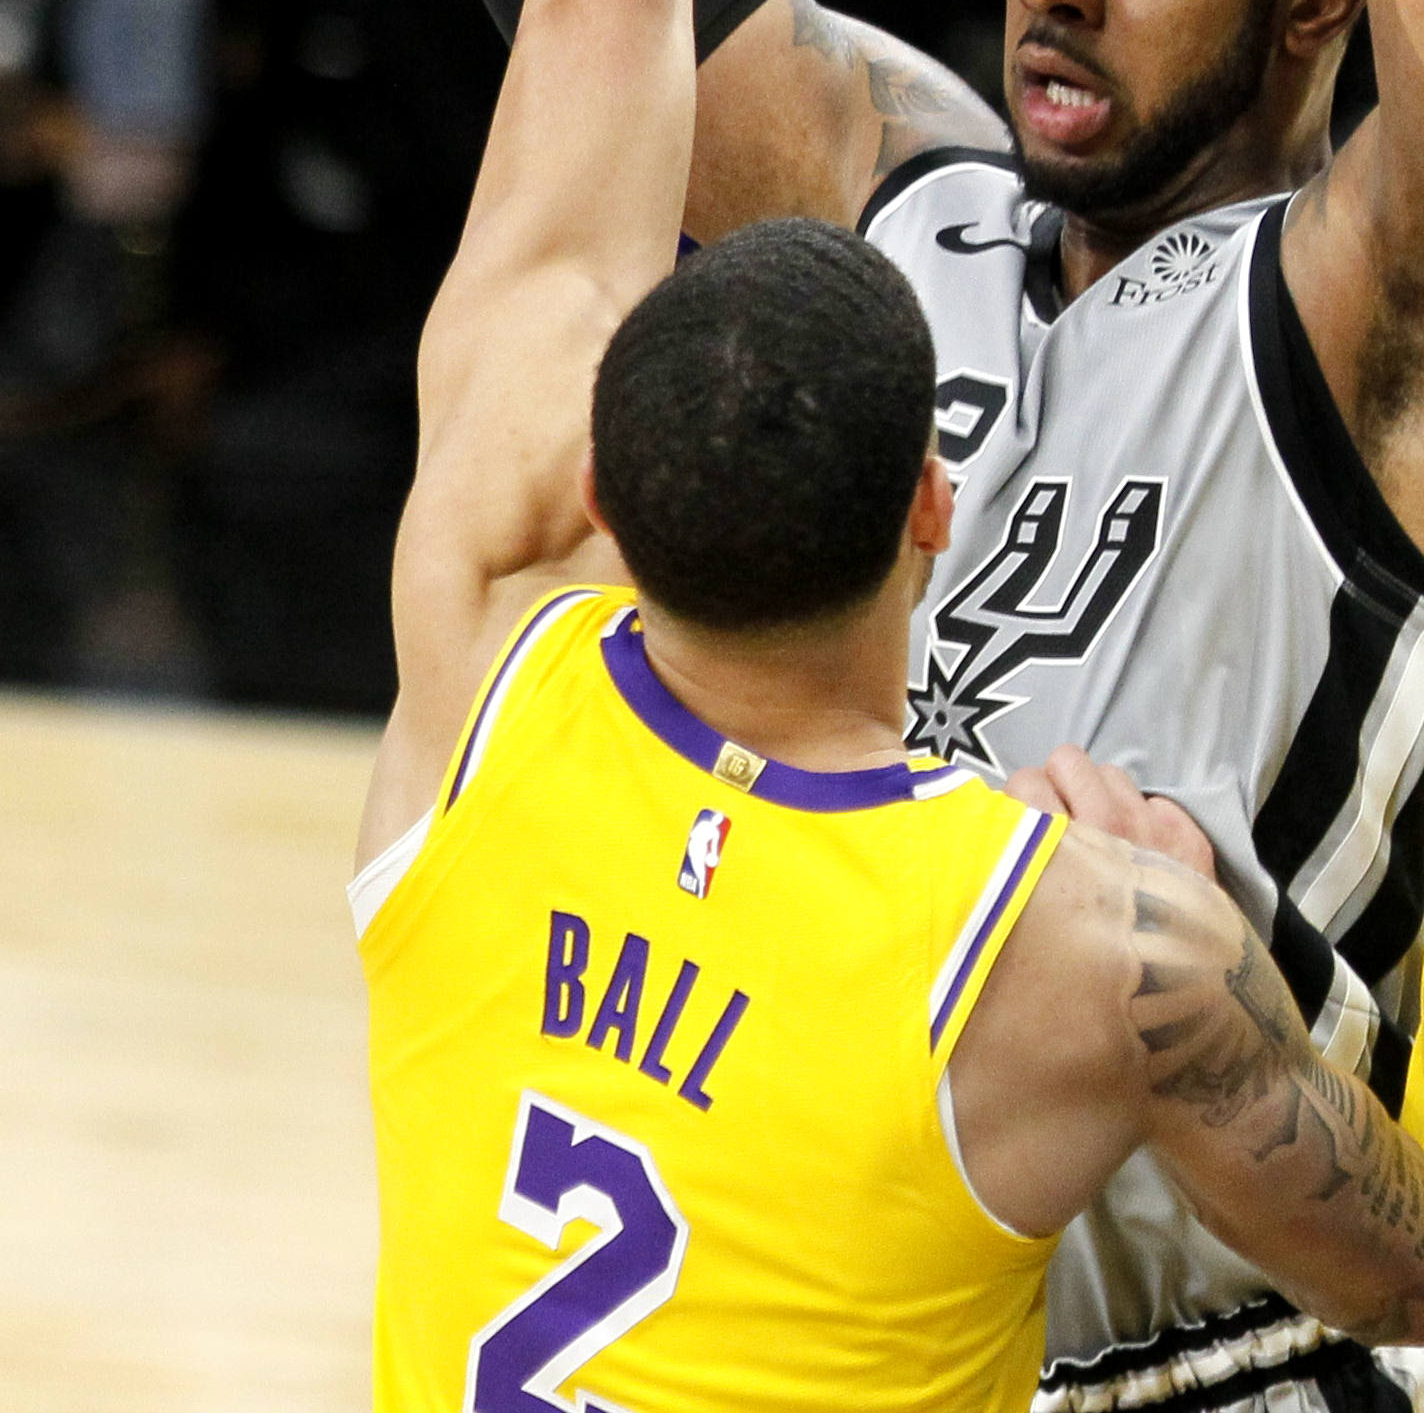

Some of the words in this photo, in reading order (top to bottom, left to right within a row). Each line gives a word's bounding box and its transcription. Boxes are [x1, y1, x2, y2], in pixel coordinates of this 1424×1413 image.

[1107, 262, 1216, 306] Frost
[679, 871, 699, 894] NBA
[540, 909, 751, 1113] BALL
[464, 1088, 690, 1413] 2
